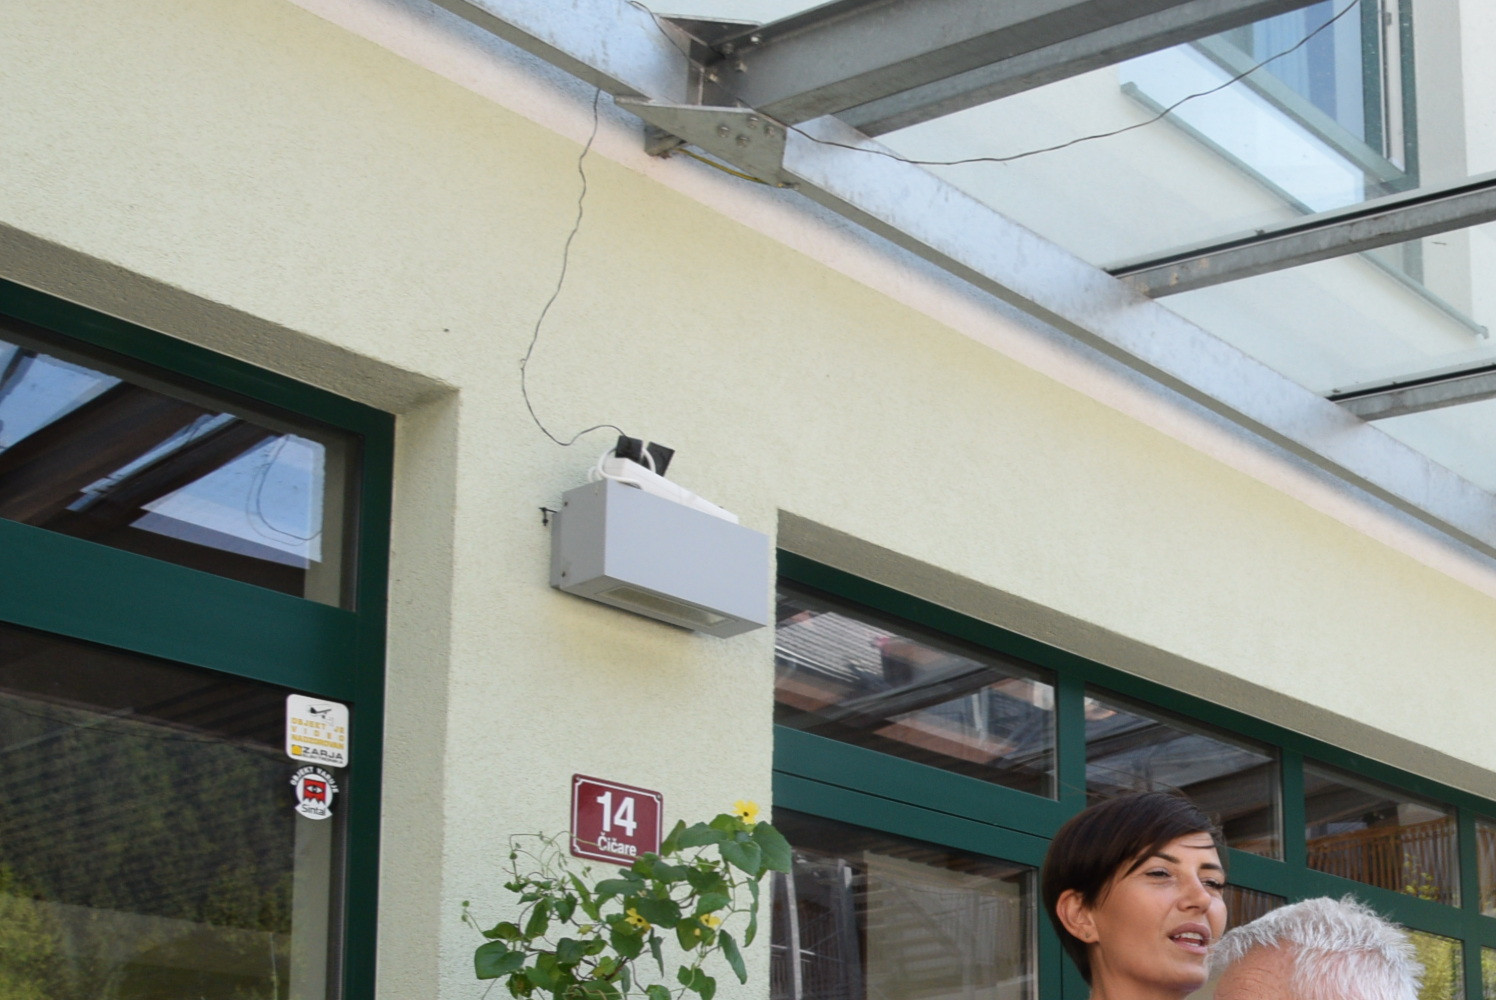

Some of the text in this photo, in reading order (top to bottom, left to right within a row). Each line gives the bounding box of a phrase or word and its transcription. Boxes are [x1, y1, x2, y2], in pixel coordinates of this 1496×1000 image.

[302, 746, 344, 760] ZARJA
[290, 766, 340, 793] OBJEKT VARUJE
[301, 803, 327, 816] Sintal
[596, 790, 638, 837] 14
[597, 831, 637, 857] Čičare
